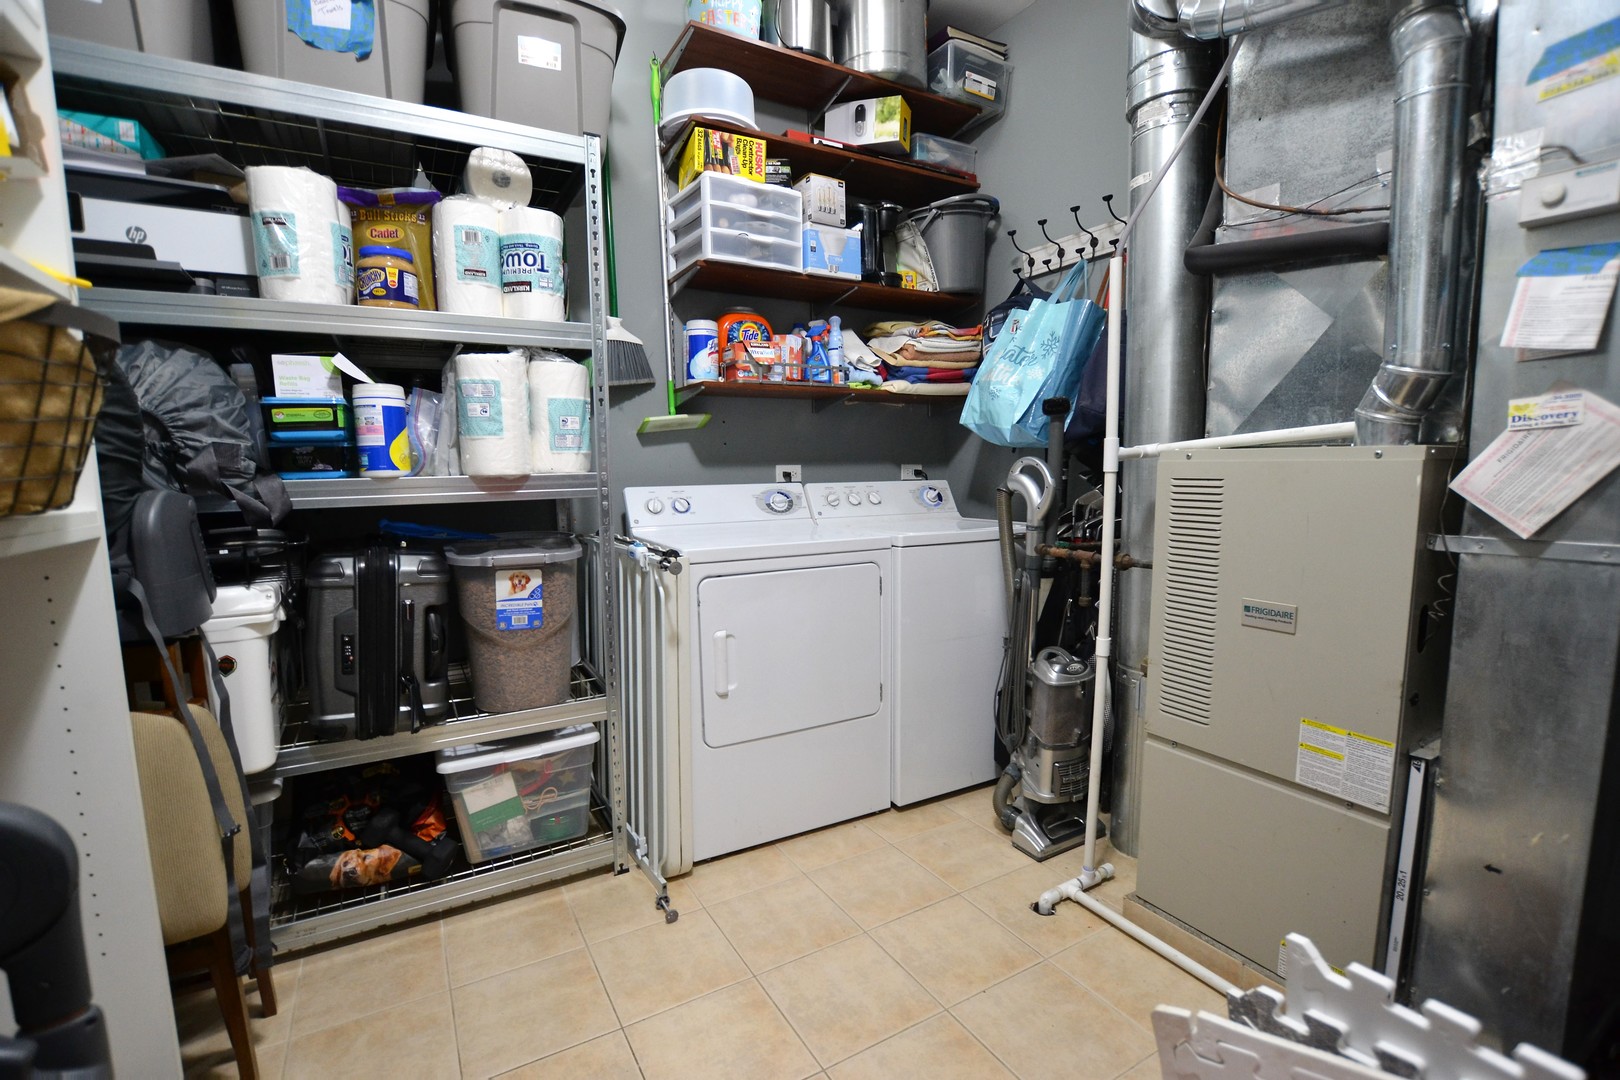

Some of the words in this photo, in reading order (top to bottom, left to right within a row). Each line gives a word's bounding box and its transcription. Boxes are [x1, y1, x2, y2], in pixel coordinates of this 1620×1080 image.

[735, 137, 743, 156] Bags
[754, 142, 764, 178] HUSKY
[359, 208, 381, 221] Bull
[383, 210, 418, 223] Sticks
[126, 225, 147, 244] hp
[369, 228, 400, 239] Cadet
[503, 284, 531, 293] KIRKLAND
[742, 329, 760, 341] Tide
[1511, 411, 1579, 424] Discovery
[1251, 606, 1295, 621] FRIGIDAIRE
